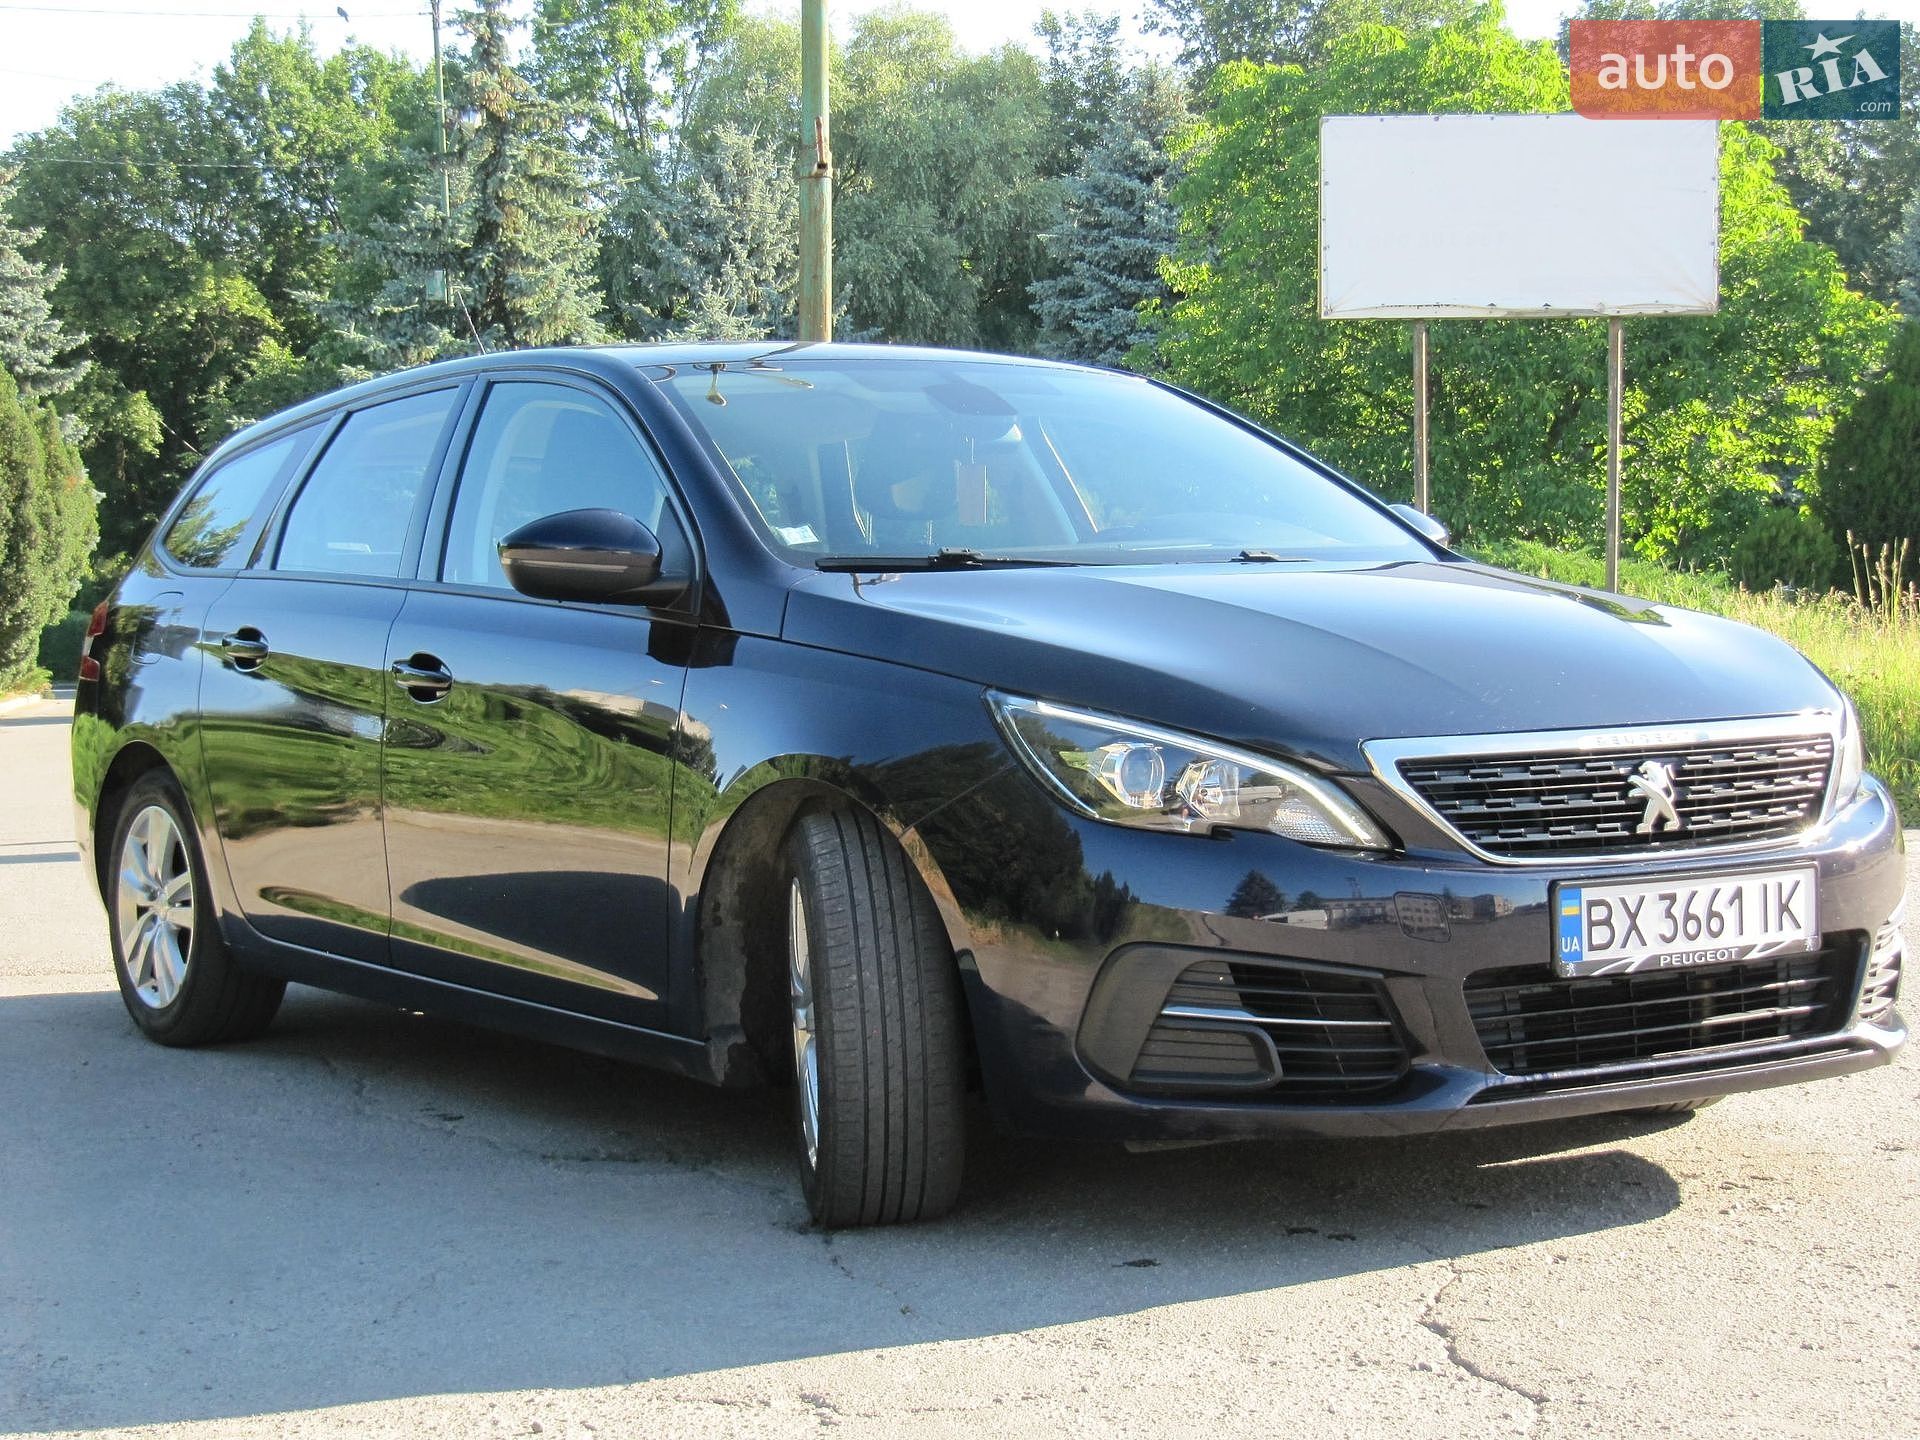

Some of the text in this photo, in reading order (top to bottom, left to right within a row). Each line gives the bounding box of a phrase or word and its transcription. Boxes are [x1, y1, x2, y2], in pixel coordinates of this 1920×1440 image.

[1586, 880, 1801, 952] BX 3661 IK
[1561, 937, 1580, 952] UA
[1660, 947, 1739, 967] PEUGEOT
